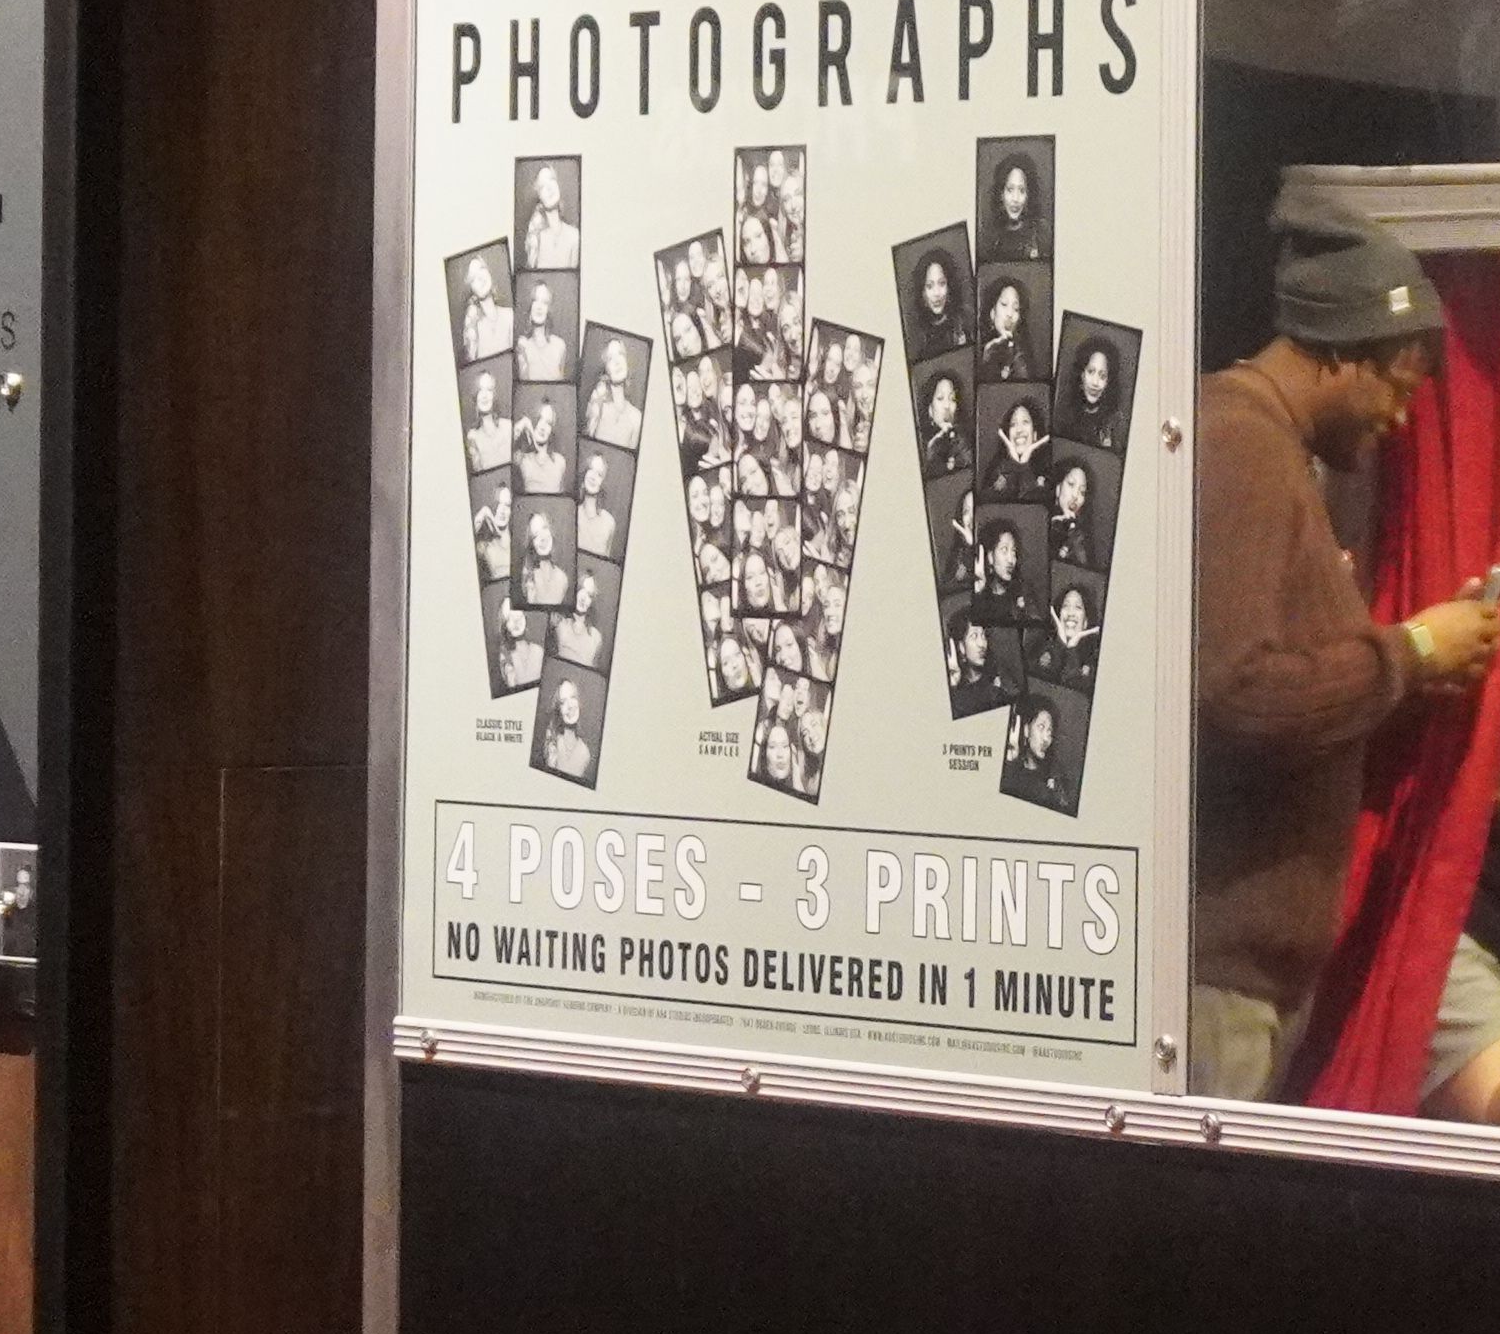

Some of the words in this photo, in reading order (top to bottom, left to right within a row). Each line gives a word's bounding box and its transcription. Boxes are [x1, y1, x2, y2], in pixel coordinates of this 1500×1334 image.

[446, 821, 479, 900] 4
[508, 823, 708, 922] POSES
[796, 845, 832, 932] 3
[865, 849, 1122, 956] PRINTS
[446, 921, 481, 963] NO
[494, 925, 607, 976] WAITING
[620, 936, 730, 986] PHOTOS
[742, 947, 904, 1003] DELIVERED
[918, 964, 949, 1007] IN
[963, 967, 977, 1009] 1
[995, 969, 1115, 1023] MINUTE
